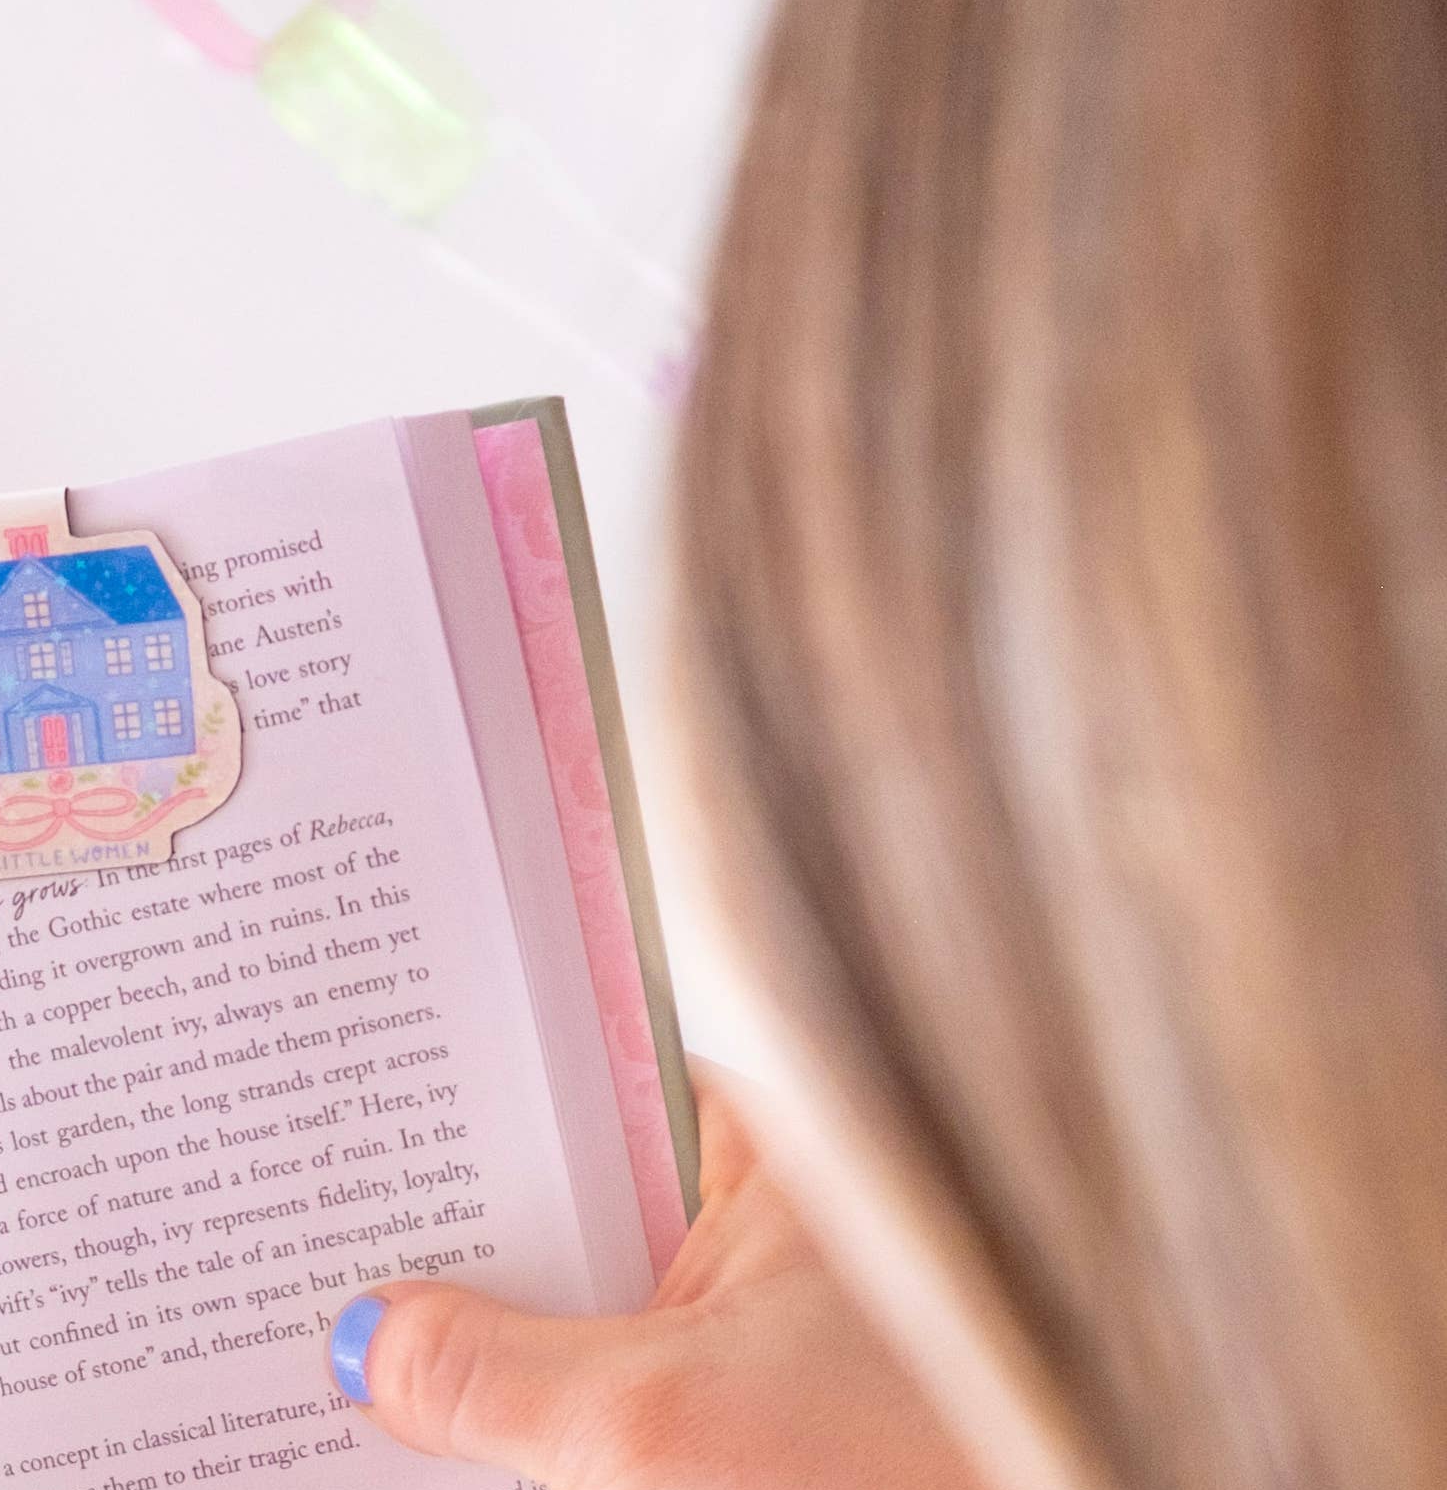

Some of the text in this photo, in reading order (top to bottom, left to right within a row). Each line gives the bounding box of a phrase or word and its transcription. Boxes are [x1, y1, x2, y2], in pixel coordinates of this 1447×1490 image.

[318, 692, 362, 715] that
[70, 842, 150, 864] WOMEN
[97, 868, 121, 888] In
[214, 838, 273, 870] pages
[280, 822, 301, 847] of
[310, 812, 393, 841] Rebecca,
[7, 926, 40, 948] the
[48, 908, 122, 938] Gothic
[131, 897, 190, 921] estate
[198, 881, 263, 905] where
[272, 865, 325, 891] most
[334, 851, 357, 876] of
[365, 846, 400, 869] the
